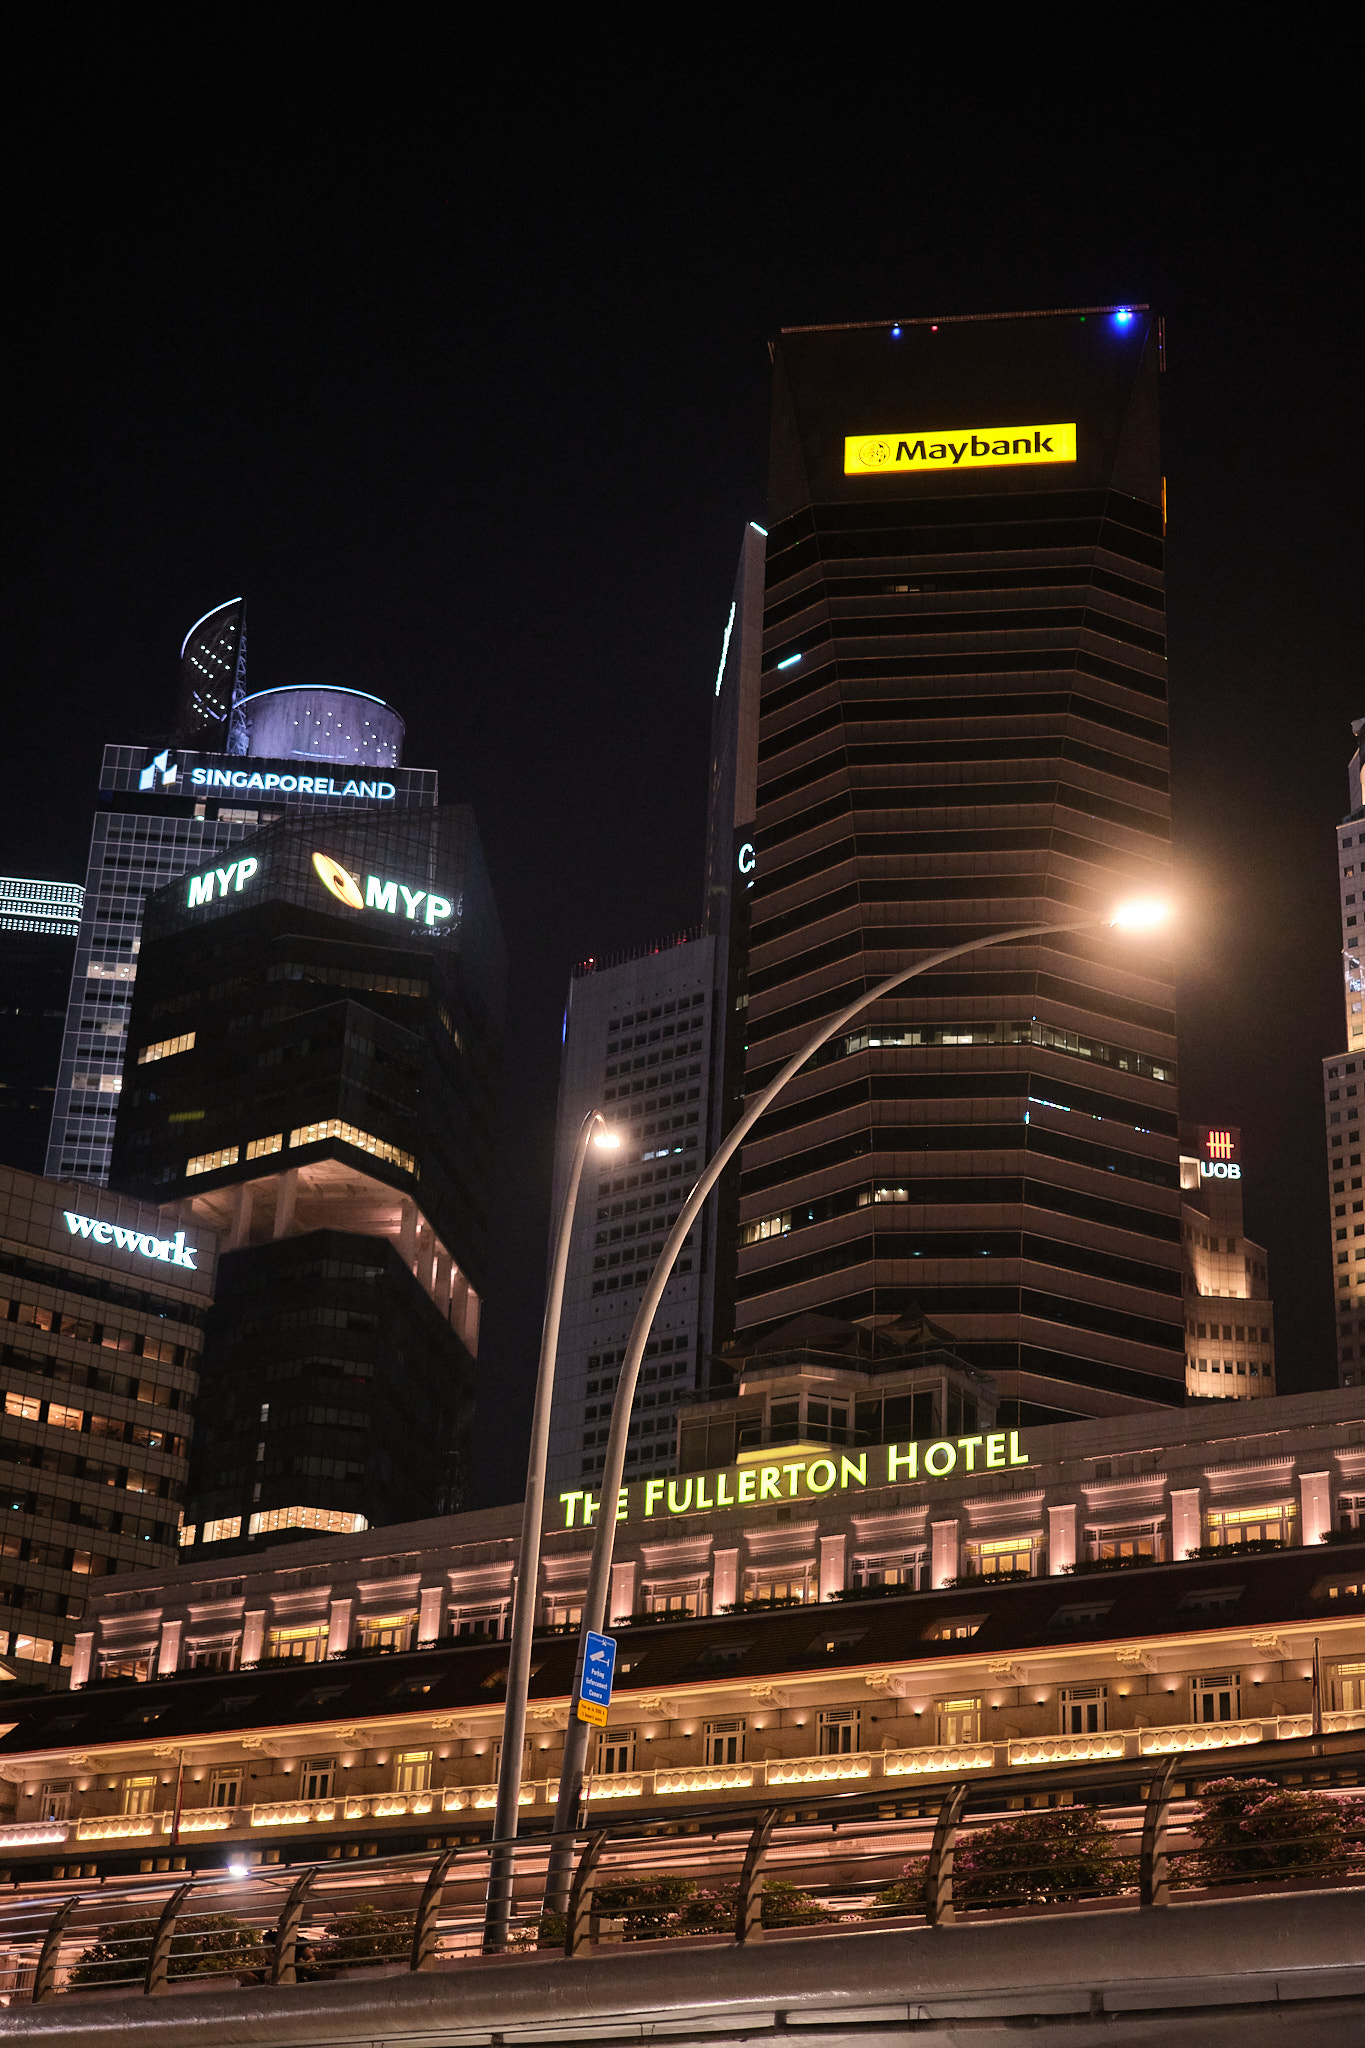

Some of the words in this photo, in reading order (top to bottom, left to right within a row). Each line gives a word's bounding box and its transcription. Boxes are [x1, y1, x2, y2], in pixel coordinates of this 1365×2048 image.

[896, 432, 1055, 464] Maybank
[191, 767, 396, 800] SINGAPORELAND
[738, 843, 755, 874] C
[187, 856, 258, 909] MYP
[365, 875, 451, 926] MYP
[1200, 1161, 1241, 1180] UOB
[63, 1210, 198, 1271] wework
[559, 1487, 629, 1528] THE
[643, 1453, 867, 1517] FULLERTON
[887, 1430, 1029, 1483] HOTEL
[585, 1676, 608, 1690] Enforcement
[591, 1667, 605, 1679] Parking
[588, 1688, 603, 1699] Camera
